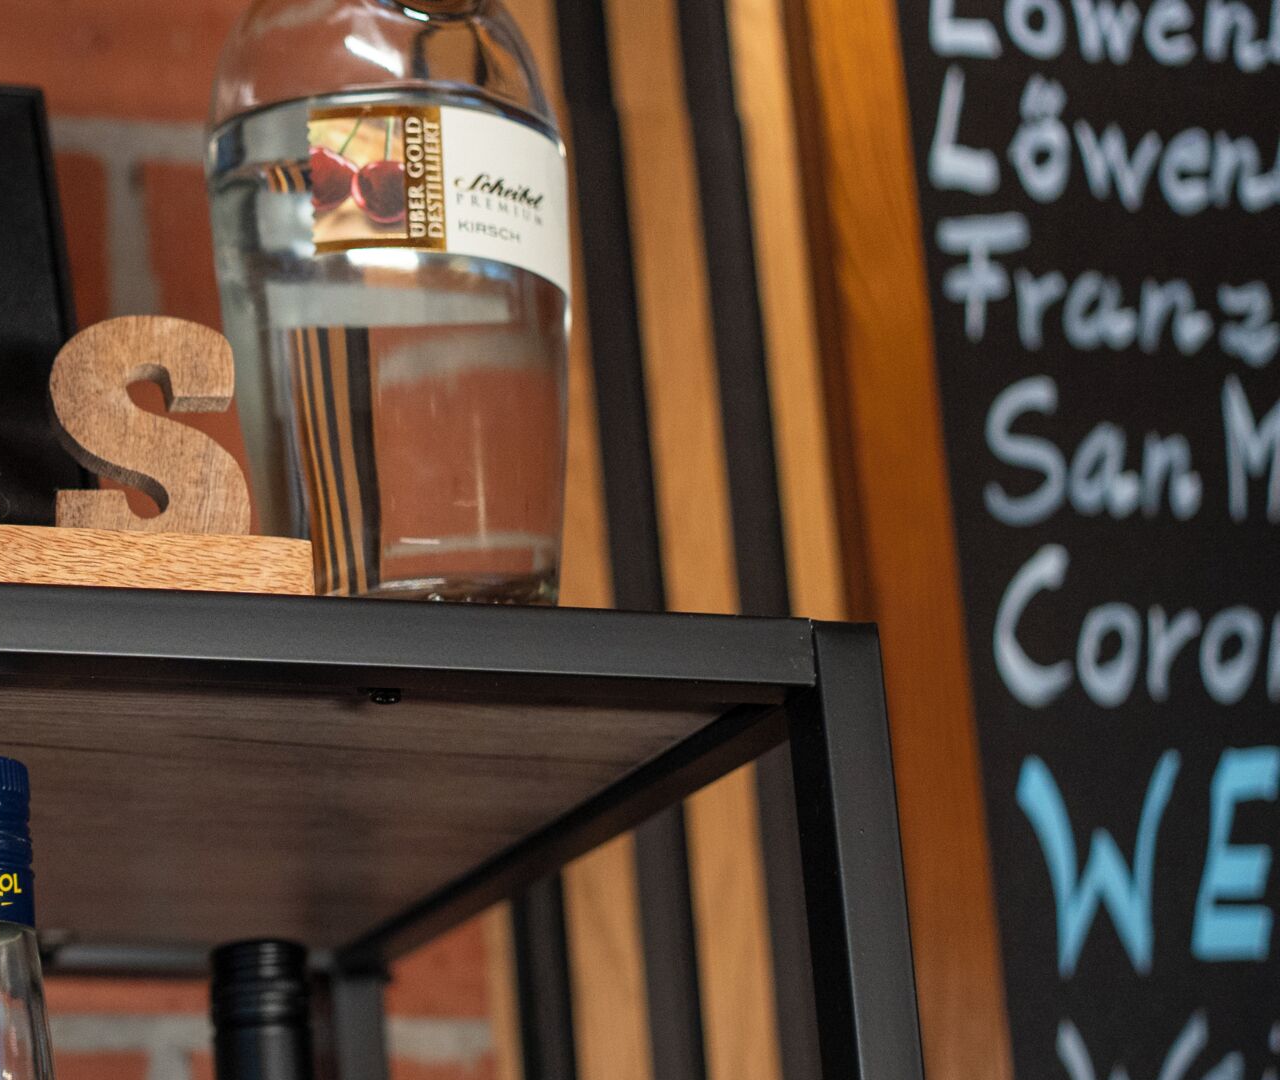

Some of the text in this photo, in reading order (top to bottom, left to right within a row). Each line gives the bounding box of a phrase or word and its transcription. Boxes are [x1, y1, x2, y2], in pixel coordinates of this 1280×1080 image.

[405, 117, 424, 178] GOLD
[424, 118, 444, 238] DESTILLIERT
[928, 63, 1280, 215] Löwen
[458, 220, 521, 242] KIRSCH
[983, 373, 1203, 527] San
[993, 543, 1280, 708] Coro
